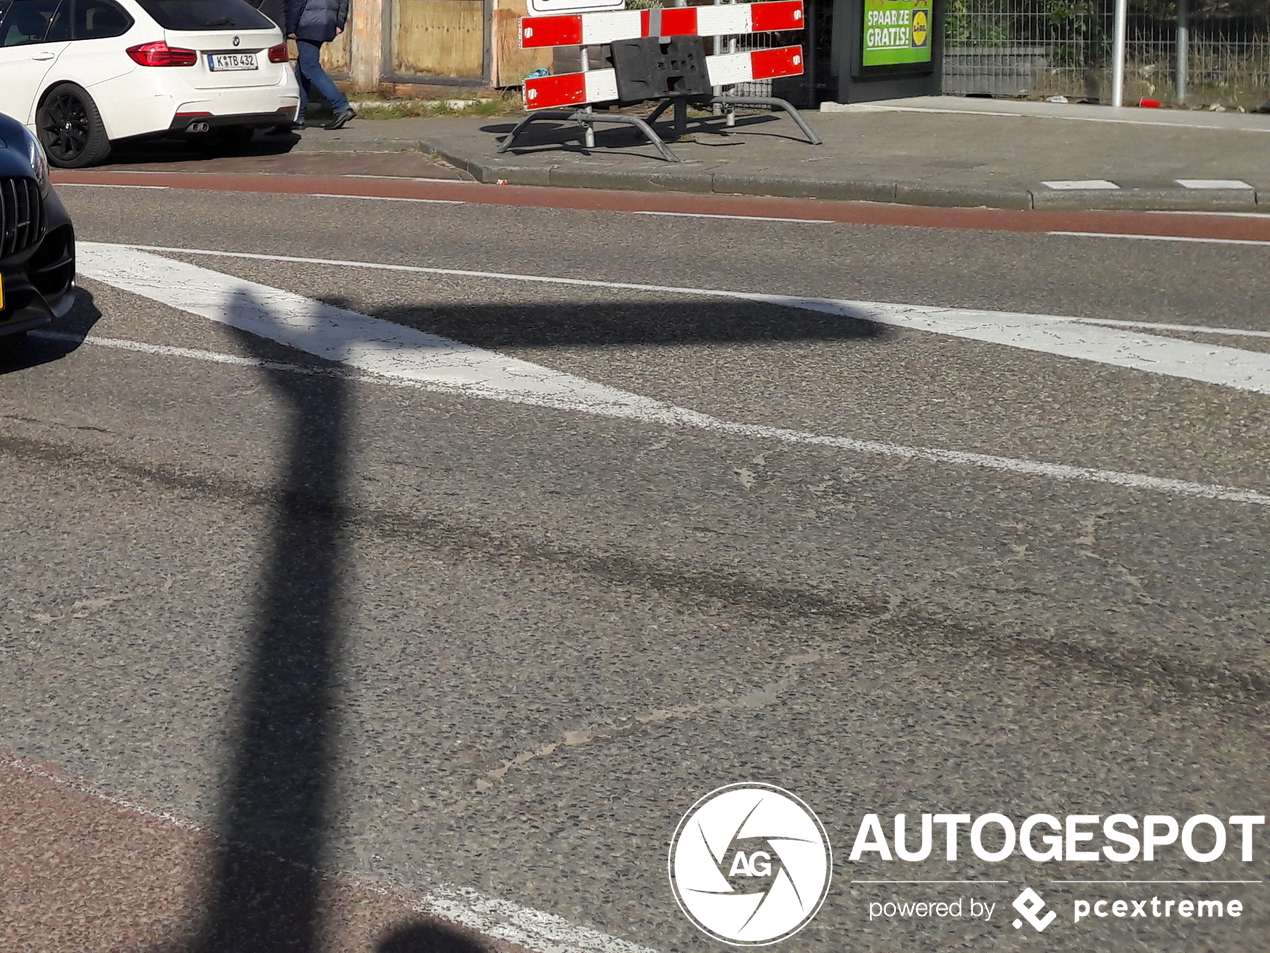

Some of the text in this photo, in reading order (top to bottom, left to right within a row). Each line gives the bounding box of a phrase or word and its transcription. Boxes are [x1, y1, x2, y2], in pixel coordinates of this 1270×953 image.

[867, 9, 910, 26] SPAAR ZE
[866, 27, 910, 47] GRATIS!
